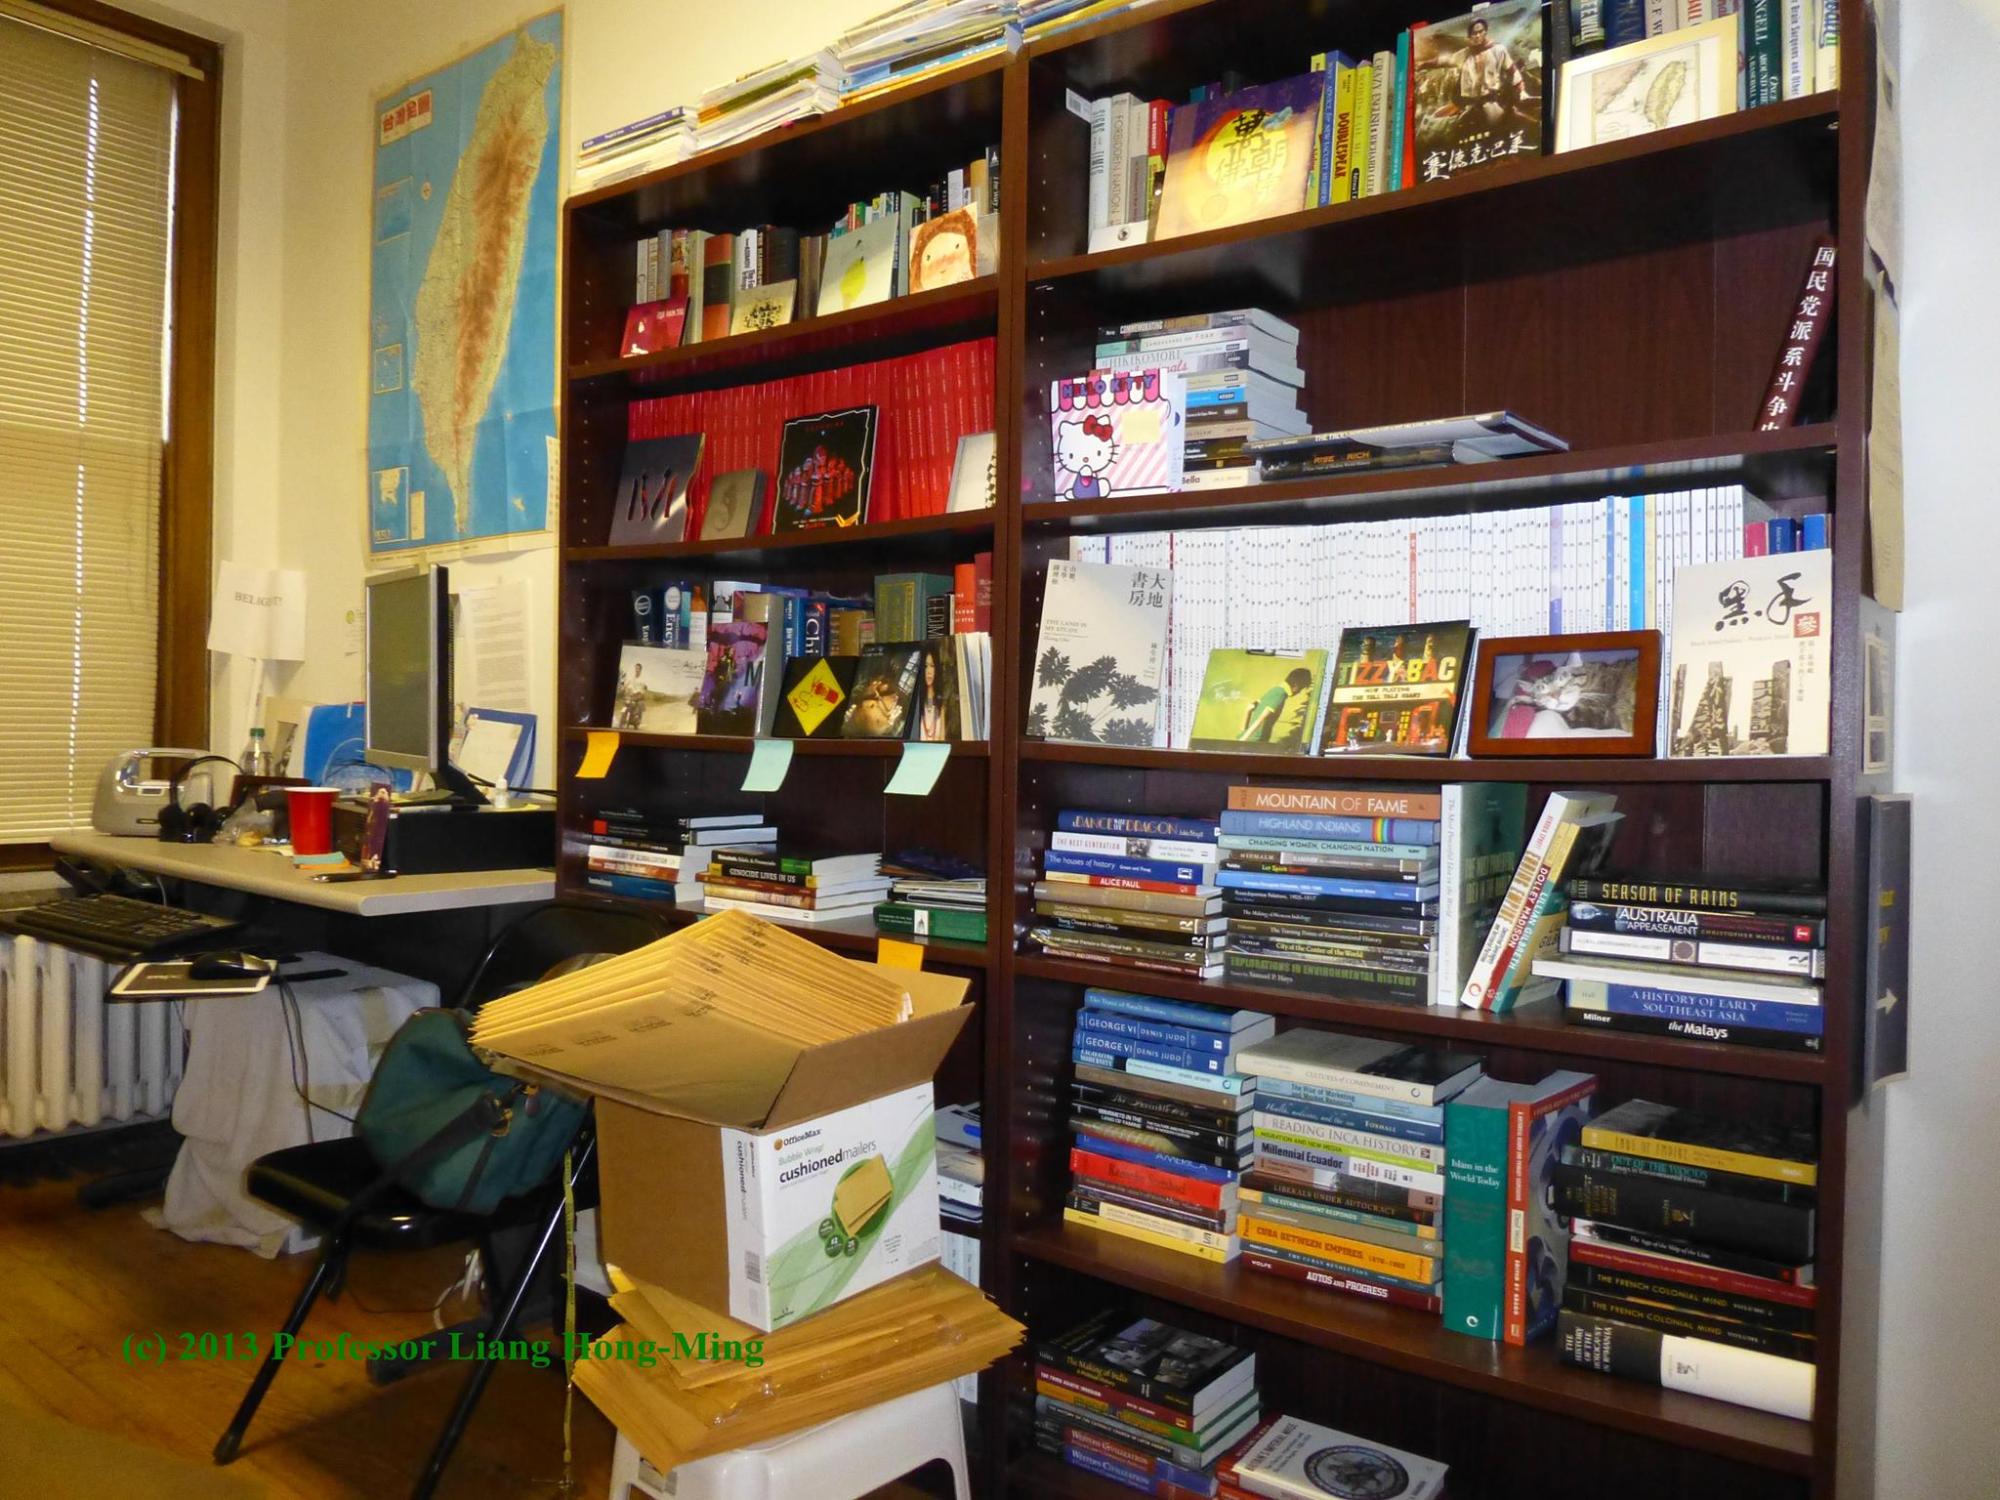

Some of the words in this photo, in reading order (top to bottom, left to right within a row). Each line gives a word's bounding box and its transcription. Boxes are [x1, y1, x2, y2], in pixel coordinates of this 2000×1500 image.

[1335, 112, 1350, 179] DOUBLESPEAK
[1406, 657, 1457, 682] BAC
[1256, 793, 1336, 810] MOUNTAIN
[1341, 797, 1362, 811] OF
[1368, 799, 1409, 814] FAME
[1258, 818, 1313, 831] HIGHLAND
[1317, 820, 1361, 833] INDIANS
[1249, 838, 1288, 848] CHANGING
[1321, 842, 1362, 852] CHANGING
[1364, 844, 1395, 854] NATION
[1049, 855, 1062, 864] The
[1063, 857, 1085, 866] houses
[1093, 860, 1117, 871] history
[729, 868, 759, 878] GENOCIDE
[760, 871, 778, 881] LIVES
[778, 873, 786, 882] IN
[787, 875, 797, 883] US
[1100, 877, 1121, 887] ALICE
[1122, 879, 1140, 889] PAUL
[1528, 867, 1549, 902] DOLLEY
[1602, 883, 1658, 901] SEASON
[1664, 887, 1683, 902] OF
[1690, 889, 1739, 907] RAINS
[1527, 892, 1548, 928] LILLIAN
[1619, 907, 1698, 926] AUSTRALIA
[1508, 905, 1533, 949] MADISON
[1626, 921, 1698, 936] APPEASEMENT
[1508, 928, 1534, 970] GILBRETH
[1630, 989, 1639, 999] A
[1639, 989, 1696, 1005] HISTORY
[1699, 996, 1716, 1007] OF
[1719, 998, 1758, 1012] EARLY
[1583, 1012, 1611, 1024] Milner
[1643, 1002, 1715, 1019] SOUTHEAST
[1717, 1009, 1746, 1023] ASIA
[1088, 1018, 1126, 1033] GEORGE
[1127, 1025, 1137, 1035] VI
[1164, 1031, 1186, 1043] JUDD
[1668, 1021, 1684, 1032] the
[1684, 1022, 1729, 1039] Malays
[1085, 1036, 1124, 1052] GEORGE
[1124, 1043, 1133, 1053] VI
[1160, 1050, 1182, 1062] JUDD
[783, 1129, 821, 1146] OfficeMax
[1272, 1118, 1325, 1139] READING
[1328, 1129, 1360, 1145] INCA
[1363, 1136, 1417, 1157] HISTORY
[1261, 1142, 1305, 1163] Millennial
[1306, 1151, 1344, 1169] Ecuador
[1451, 1158, 1473, 1170] Islam
[1484, 1164, 1498, 1174] the
[1450, 1170, 1475, 1183] World
[1477, 1176, 1500, 1190] Today
[1256, 1226, 1278, 1238] CUBA
[1280, 1229, 1323, 1250] BETWEEN
[1306, 1271, 1333, 1287] AUTOS
[1333, 1279, 1345, 1288] AND
[1346, 1280, 1389, 1298] PROGRESS
[1597, 1273, 1612, 1284] THE
[1615, 1276, 1649, 1292] FRENCH
[1651, 1283, 1699, 1302] COLONIAL
[1702, 1293, 1728, 1307] MIND
[1592, 1300, 1607, 1311] THE
[1610, 1303, 1644, 1319] FRENCH
[1646, 1311, 1694, 1330] COLONIAL
[1697, 1323, 1723, 1336] MIND
